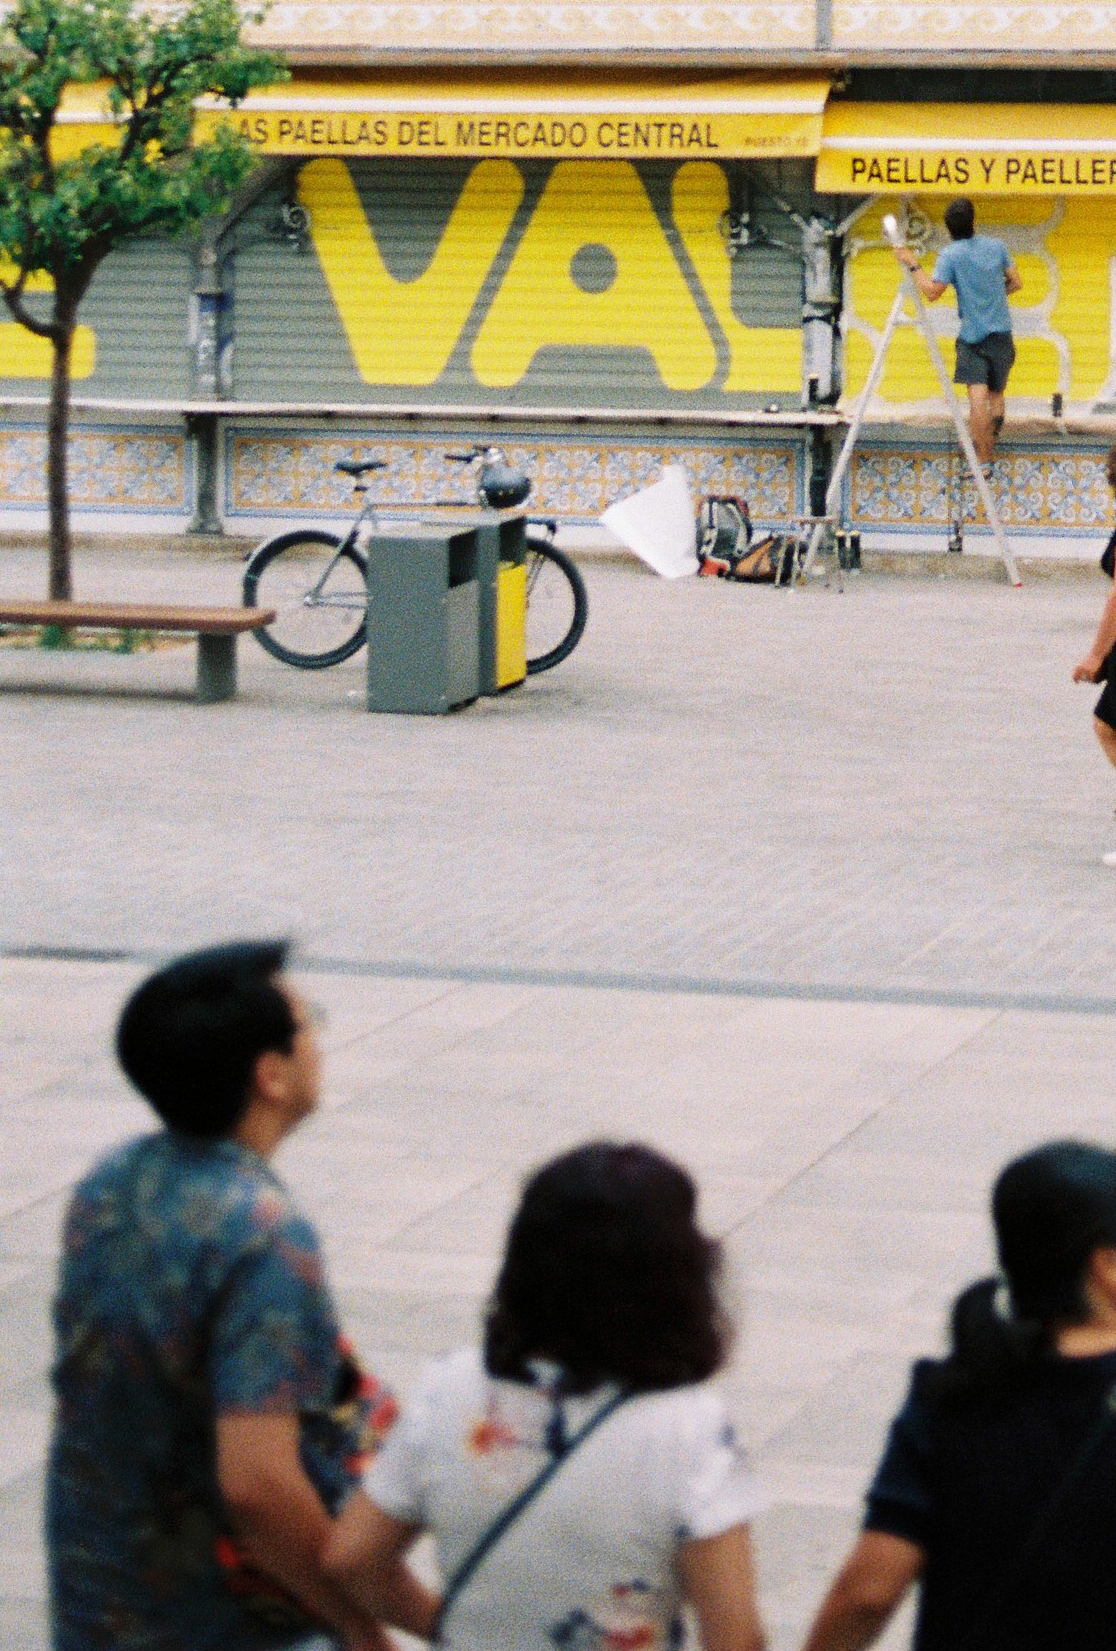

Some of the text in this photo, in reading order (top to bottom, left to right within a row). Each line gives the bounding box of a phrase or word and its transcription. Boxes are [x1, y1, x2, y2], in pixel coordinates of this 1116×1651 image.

[236, 118, 720, 149] AS PAELLAS DEL MERCADO CENTRAL
[851, 157, 970, 184] PAELLAS
[978, 158, 996, 184] Y
